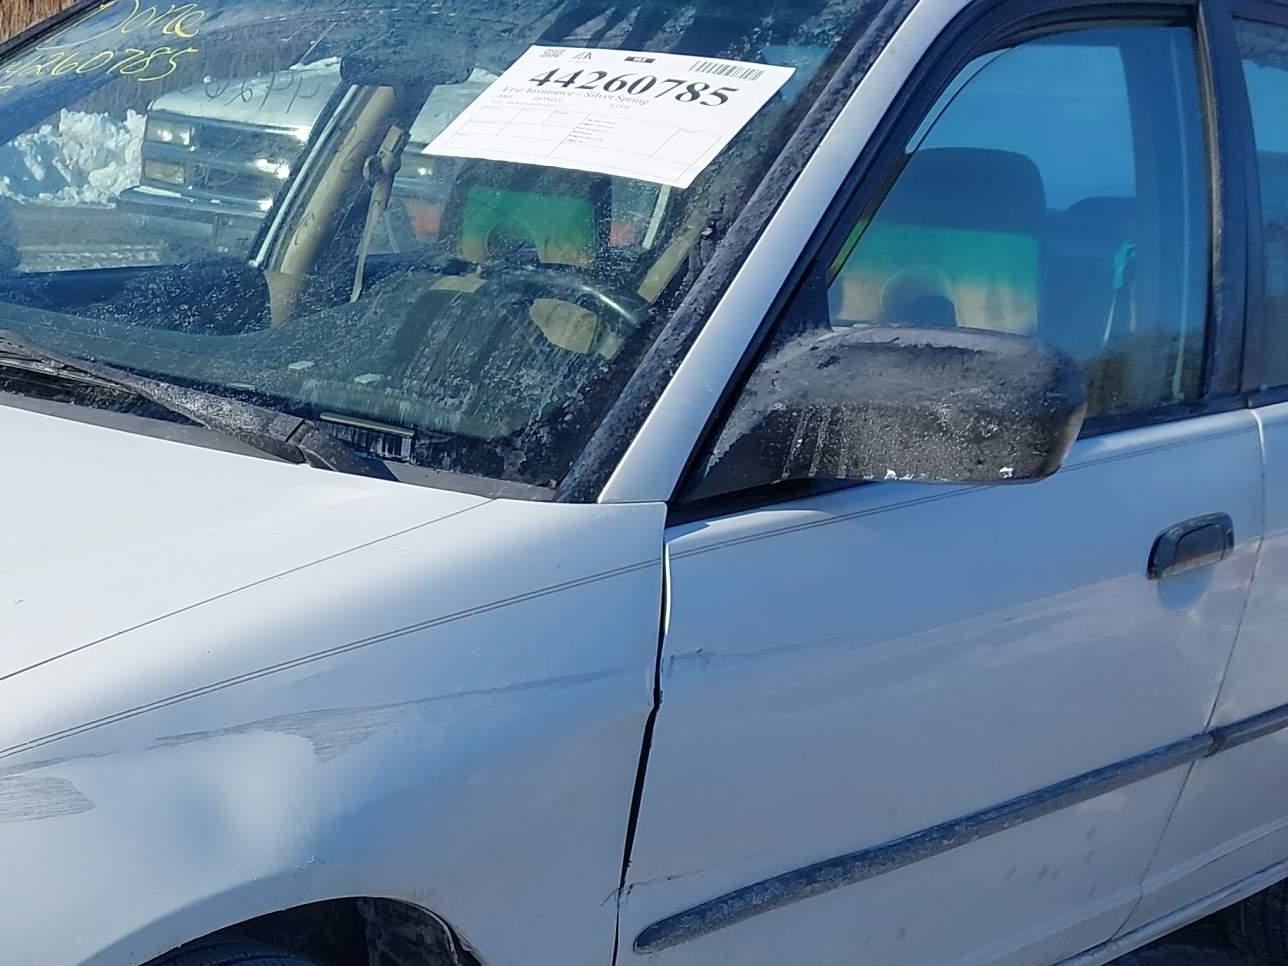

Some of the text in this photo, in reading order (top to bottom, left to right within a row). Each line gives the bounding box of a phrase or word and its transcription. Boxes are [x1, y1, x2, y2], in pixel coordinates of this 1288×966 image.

[525, 87, 576, 97] Insurance
[583, 91, 615, 100] Silver
[614, 95, 650, 106] Spring
[528, 67, 740, 107] 44260785
